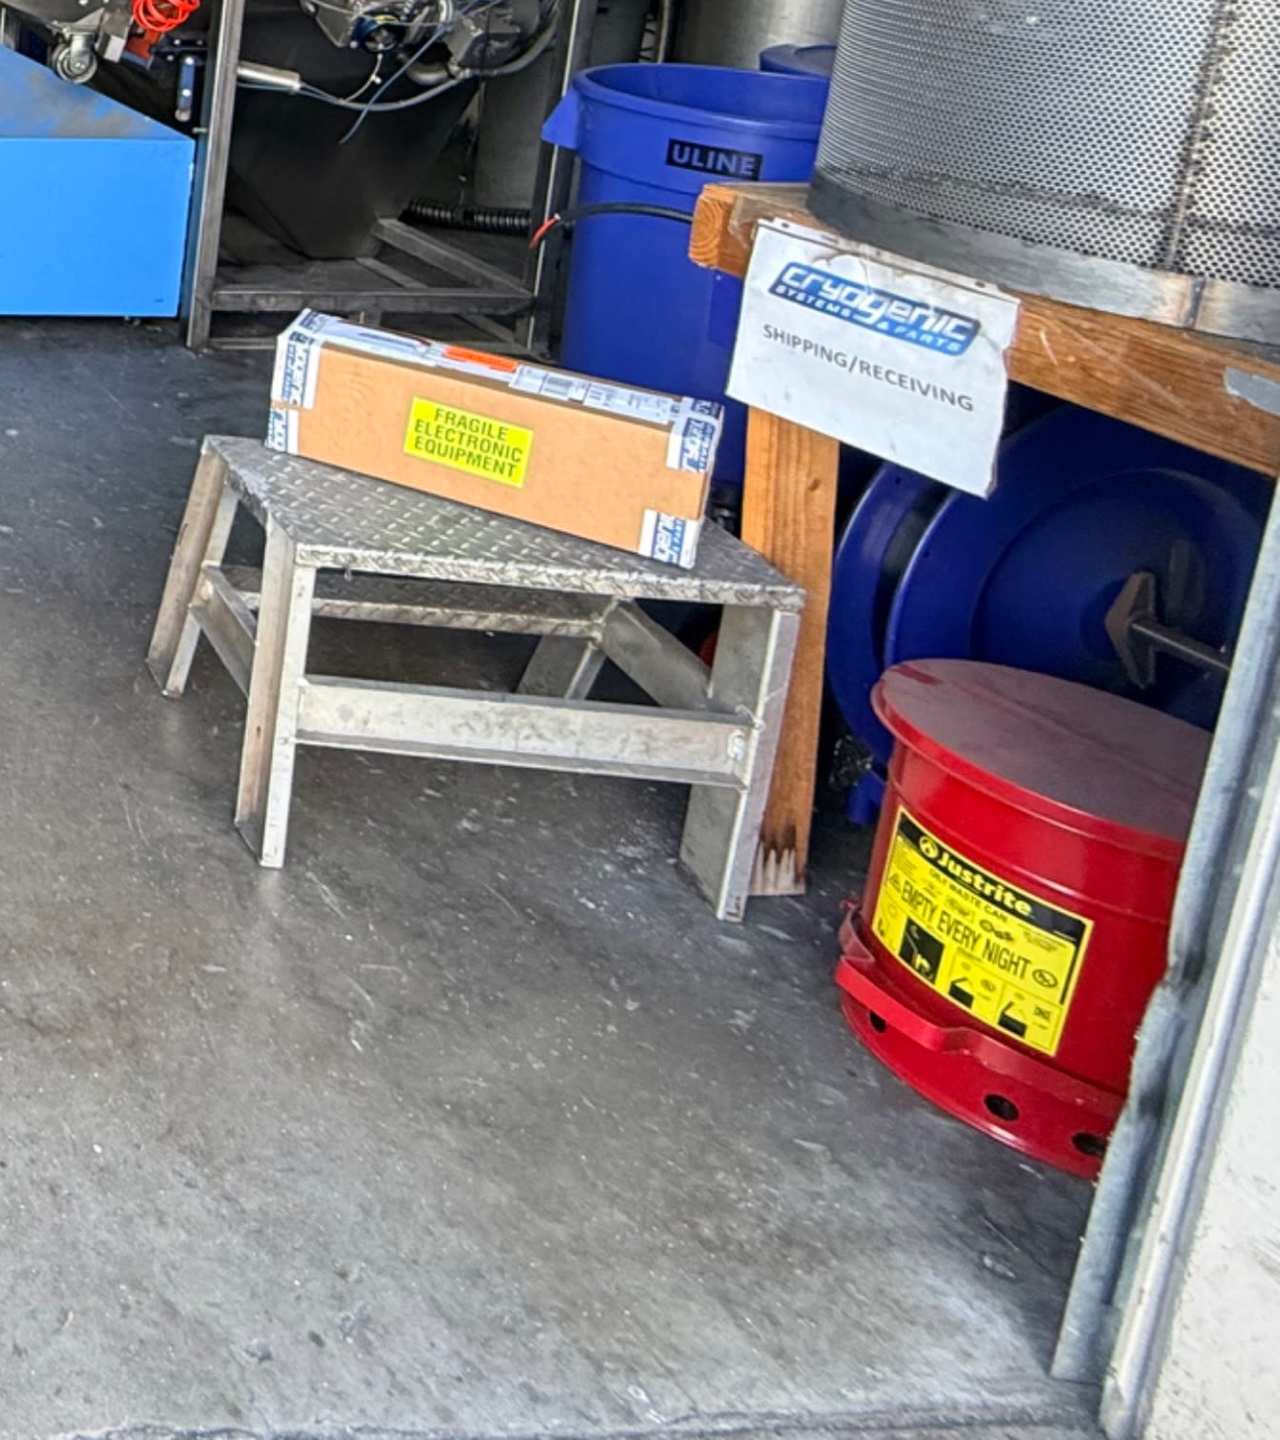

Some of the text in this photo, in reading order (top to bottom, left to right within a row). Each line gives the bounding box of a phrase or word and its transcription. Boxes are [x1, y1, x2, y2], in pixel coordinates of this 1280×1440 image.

[671, 143, 756, 176] ULINE
[775, 284, 852, 318] SYSTEMS
[894, 325, 963, 352] PARTS
[763, 324, 975, 413] SHIPPING/RECEIVING
[414, 418, 523, 463] ELECTRONIC
[433, 407, 509, 441] FRAGILE
[413, 434, 518, 478] EQUIPMENT
[937, 852, 1032, 917] Justrite
[901, 881, 938, 921] EMPTY
[939, 911, 982, 953] EVERY
[982, 937, 1032, 981] NIGHT
